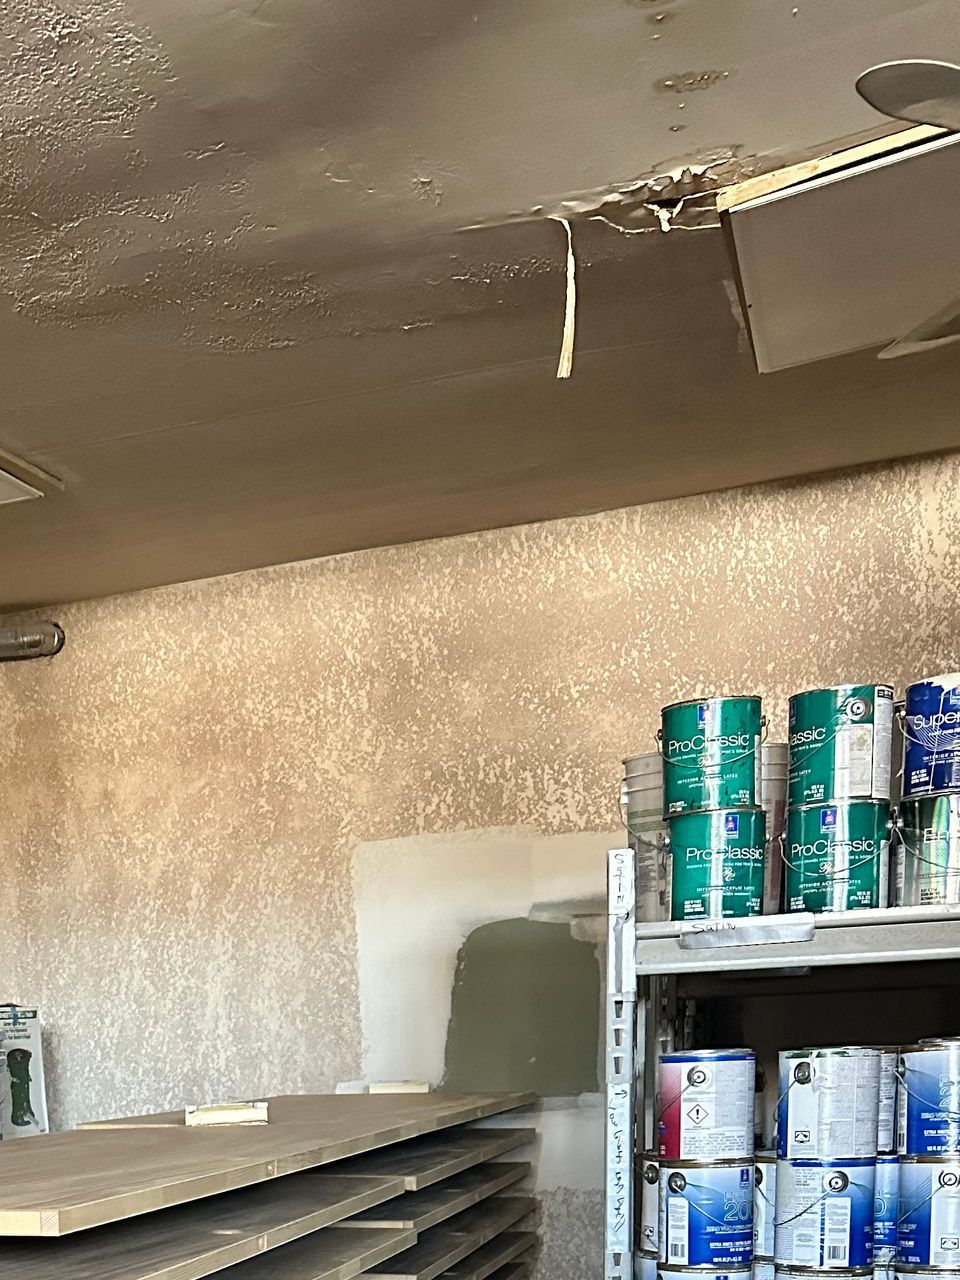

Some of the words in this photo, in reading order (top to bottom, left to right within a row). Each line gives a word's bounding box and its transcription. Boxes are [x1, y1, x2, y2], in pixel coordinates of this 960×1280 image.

[669, 732, 749, 755] ProCssic
[790, 726, 826, 745] assic
[686, 845, 763, 861] ProClassic
[792, 837, 874, 858] ProClassic
[724, 1201, 753, 1221] 20
